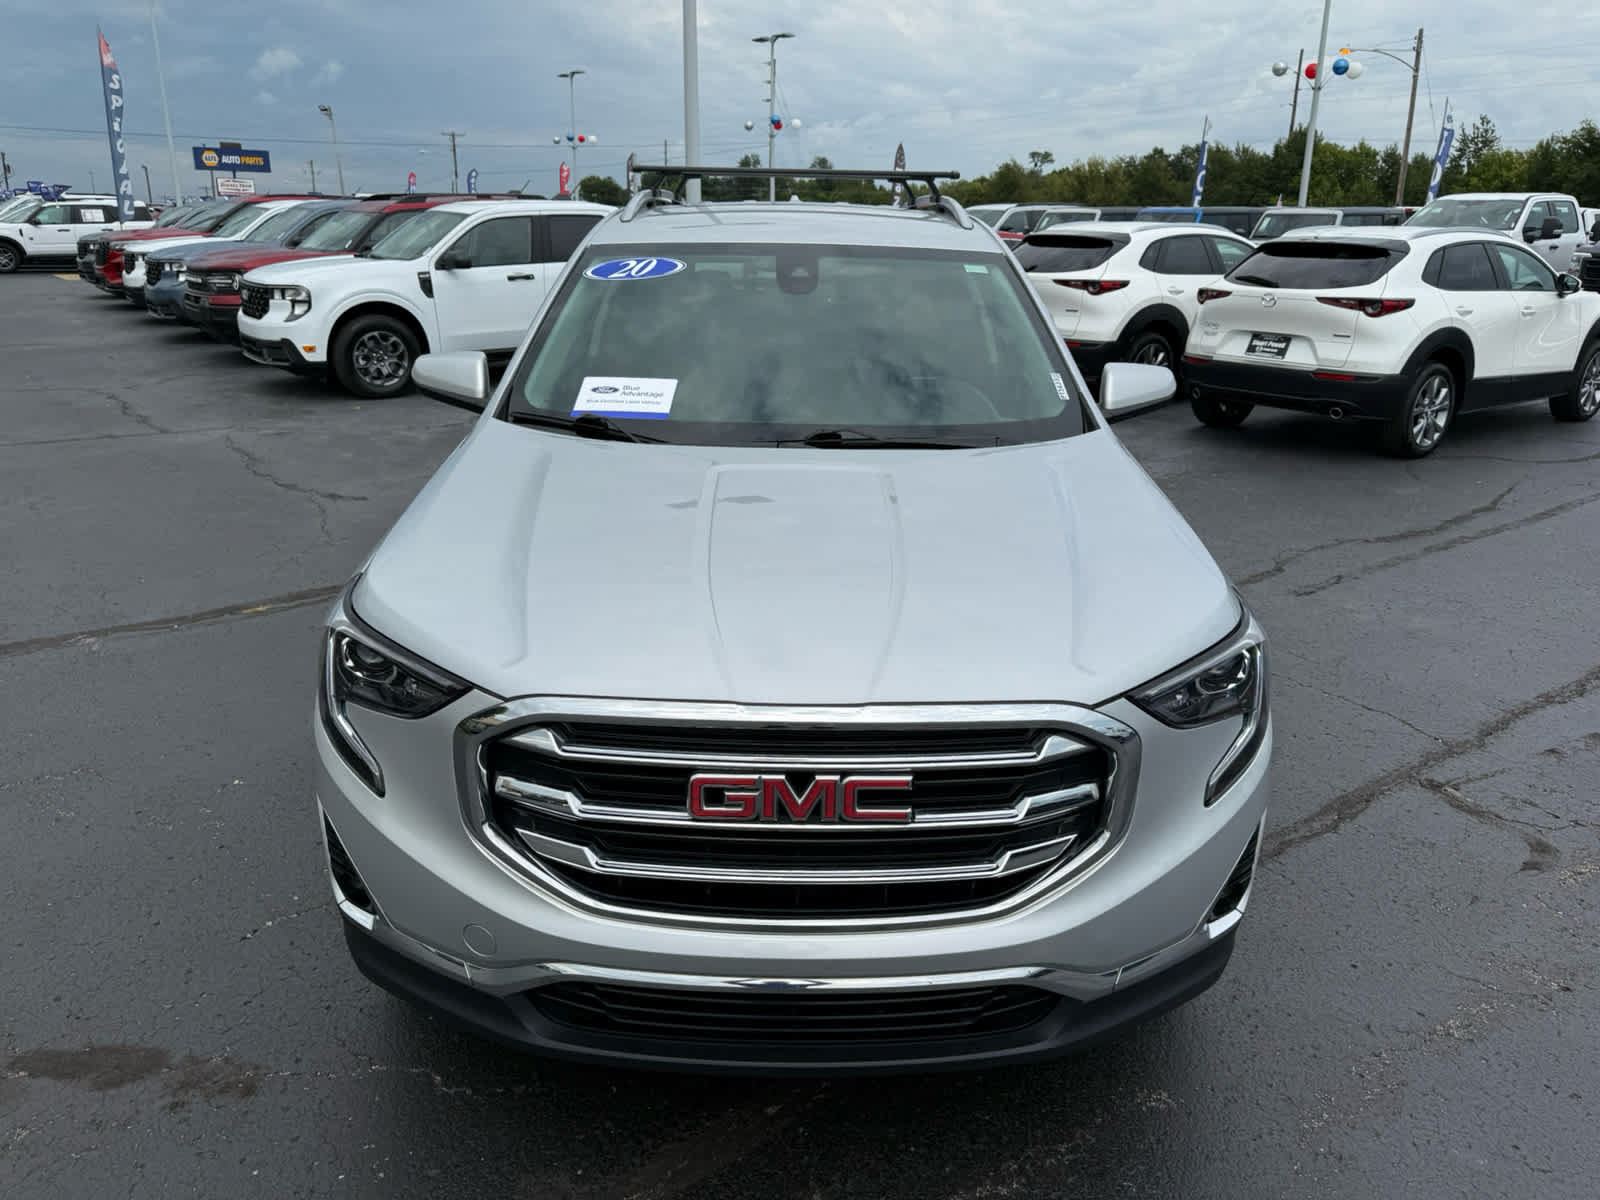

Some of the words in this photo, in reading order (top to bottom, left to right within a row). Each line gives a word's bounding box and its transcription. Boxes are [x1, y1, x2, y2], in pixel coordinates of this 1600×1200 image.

[221, 154, 240, 164] AUTO
[240, 155, 264, 166] PARTS
[608, 259, 657, 278] 20
[620, 391, 664, 399] Advantage
[687, 773, 913, 822] GMC
